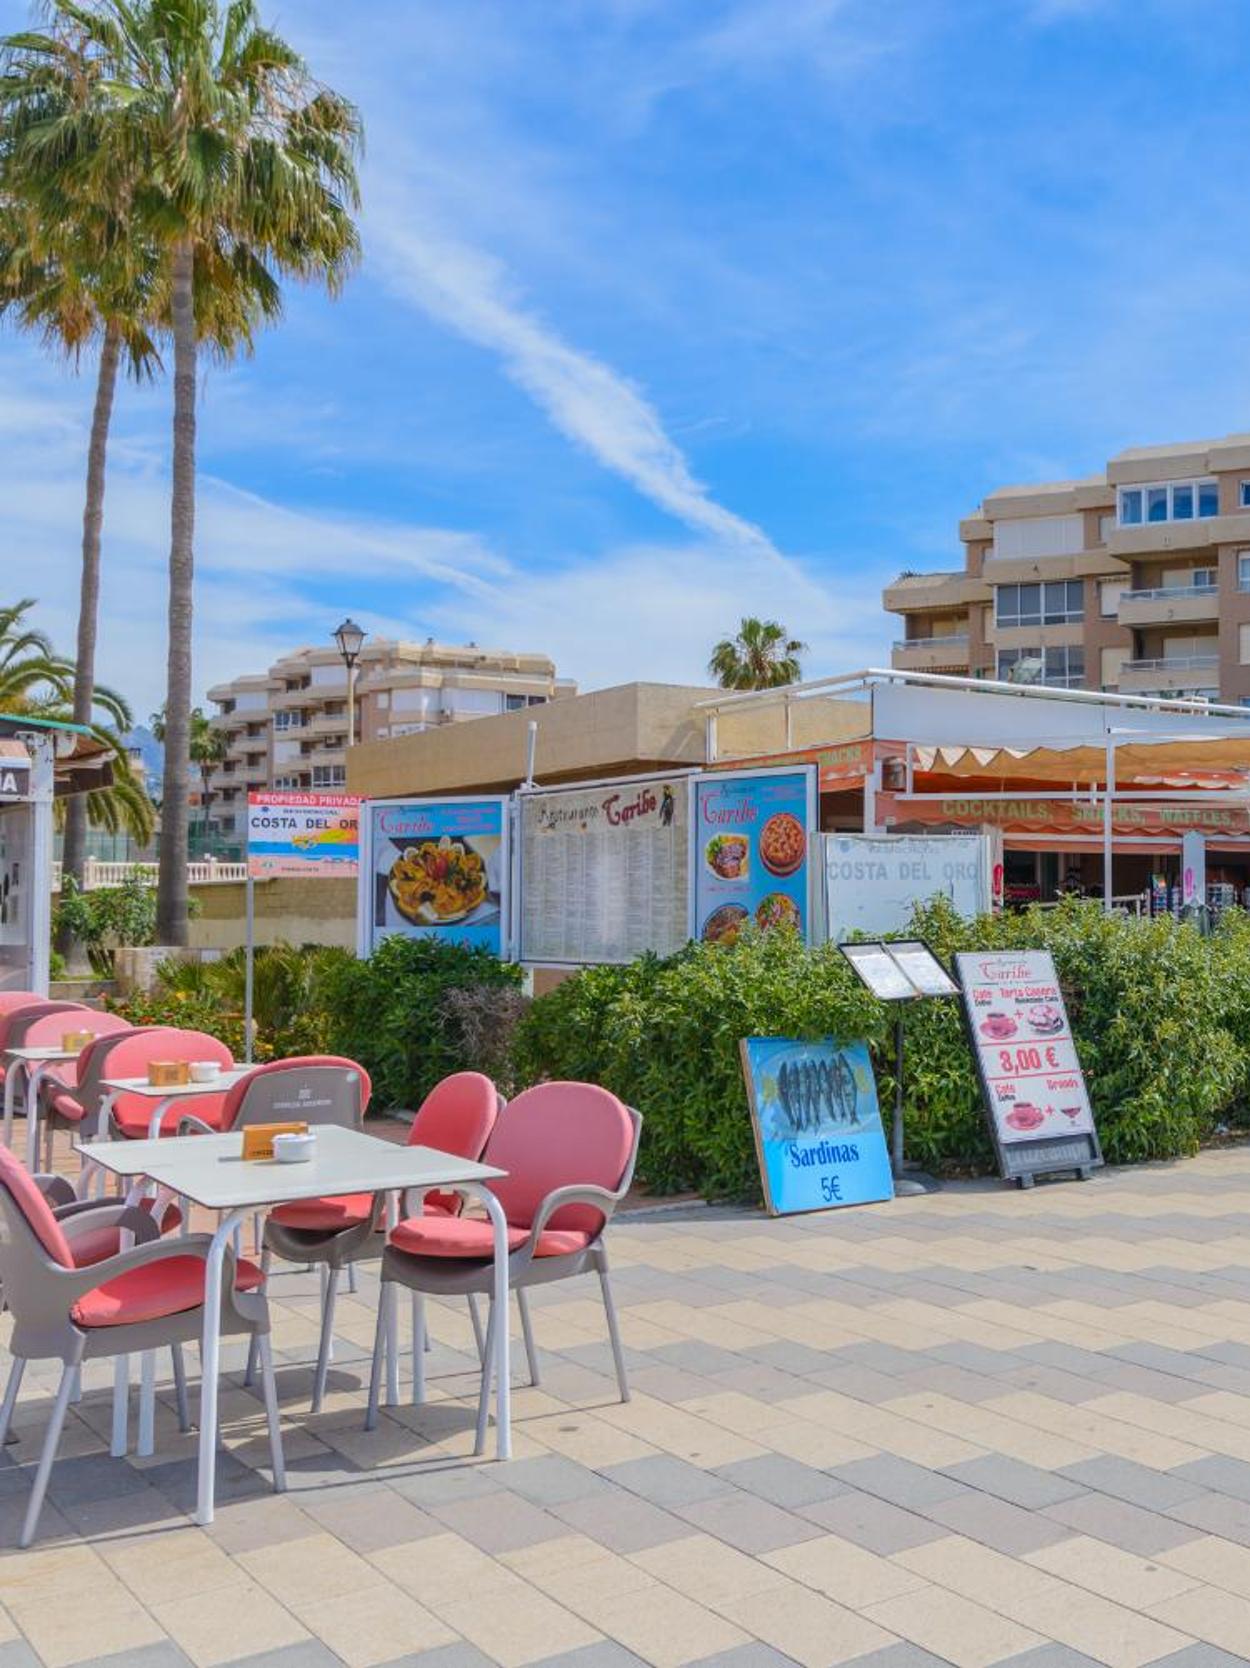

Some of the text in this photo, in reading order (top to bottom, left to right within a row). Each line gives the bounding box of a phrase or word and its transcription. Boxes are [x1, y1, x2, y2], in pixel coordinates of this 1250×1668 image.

[251, 817, 359, 830] COSTA DEL OR
[828, 861, 978, 880] COSTA DEL ORO
[1045, 1046, 1060, 1068] €
[789, 1140, 860, 1168] Sardinas
[820, 1175, 844, 1202] 5€
